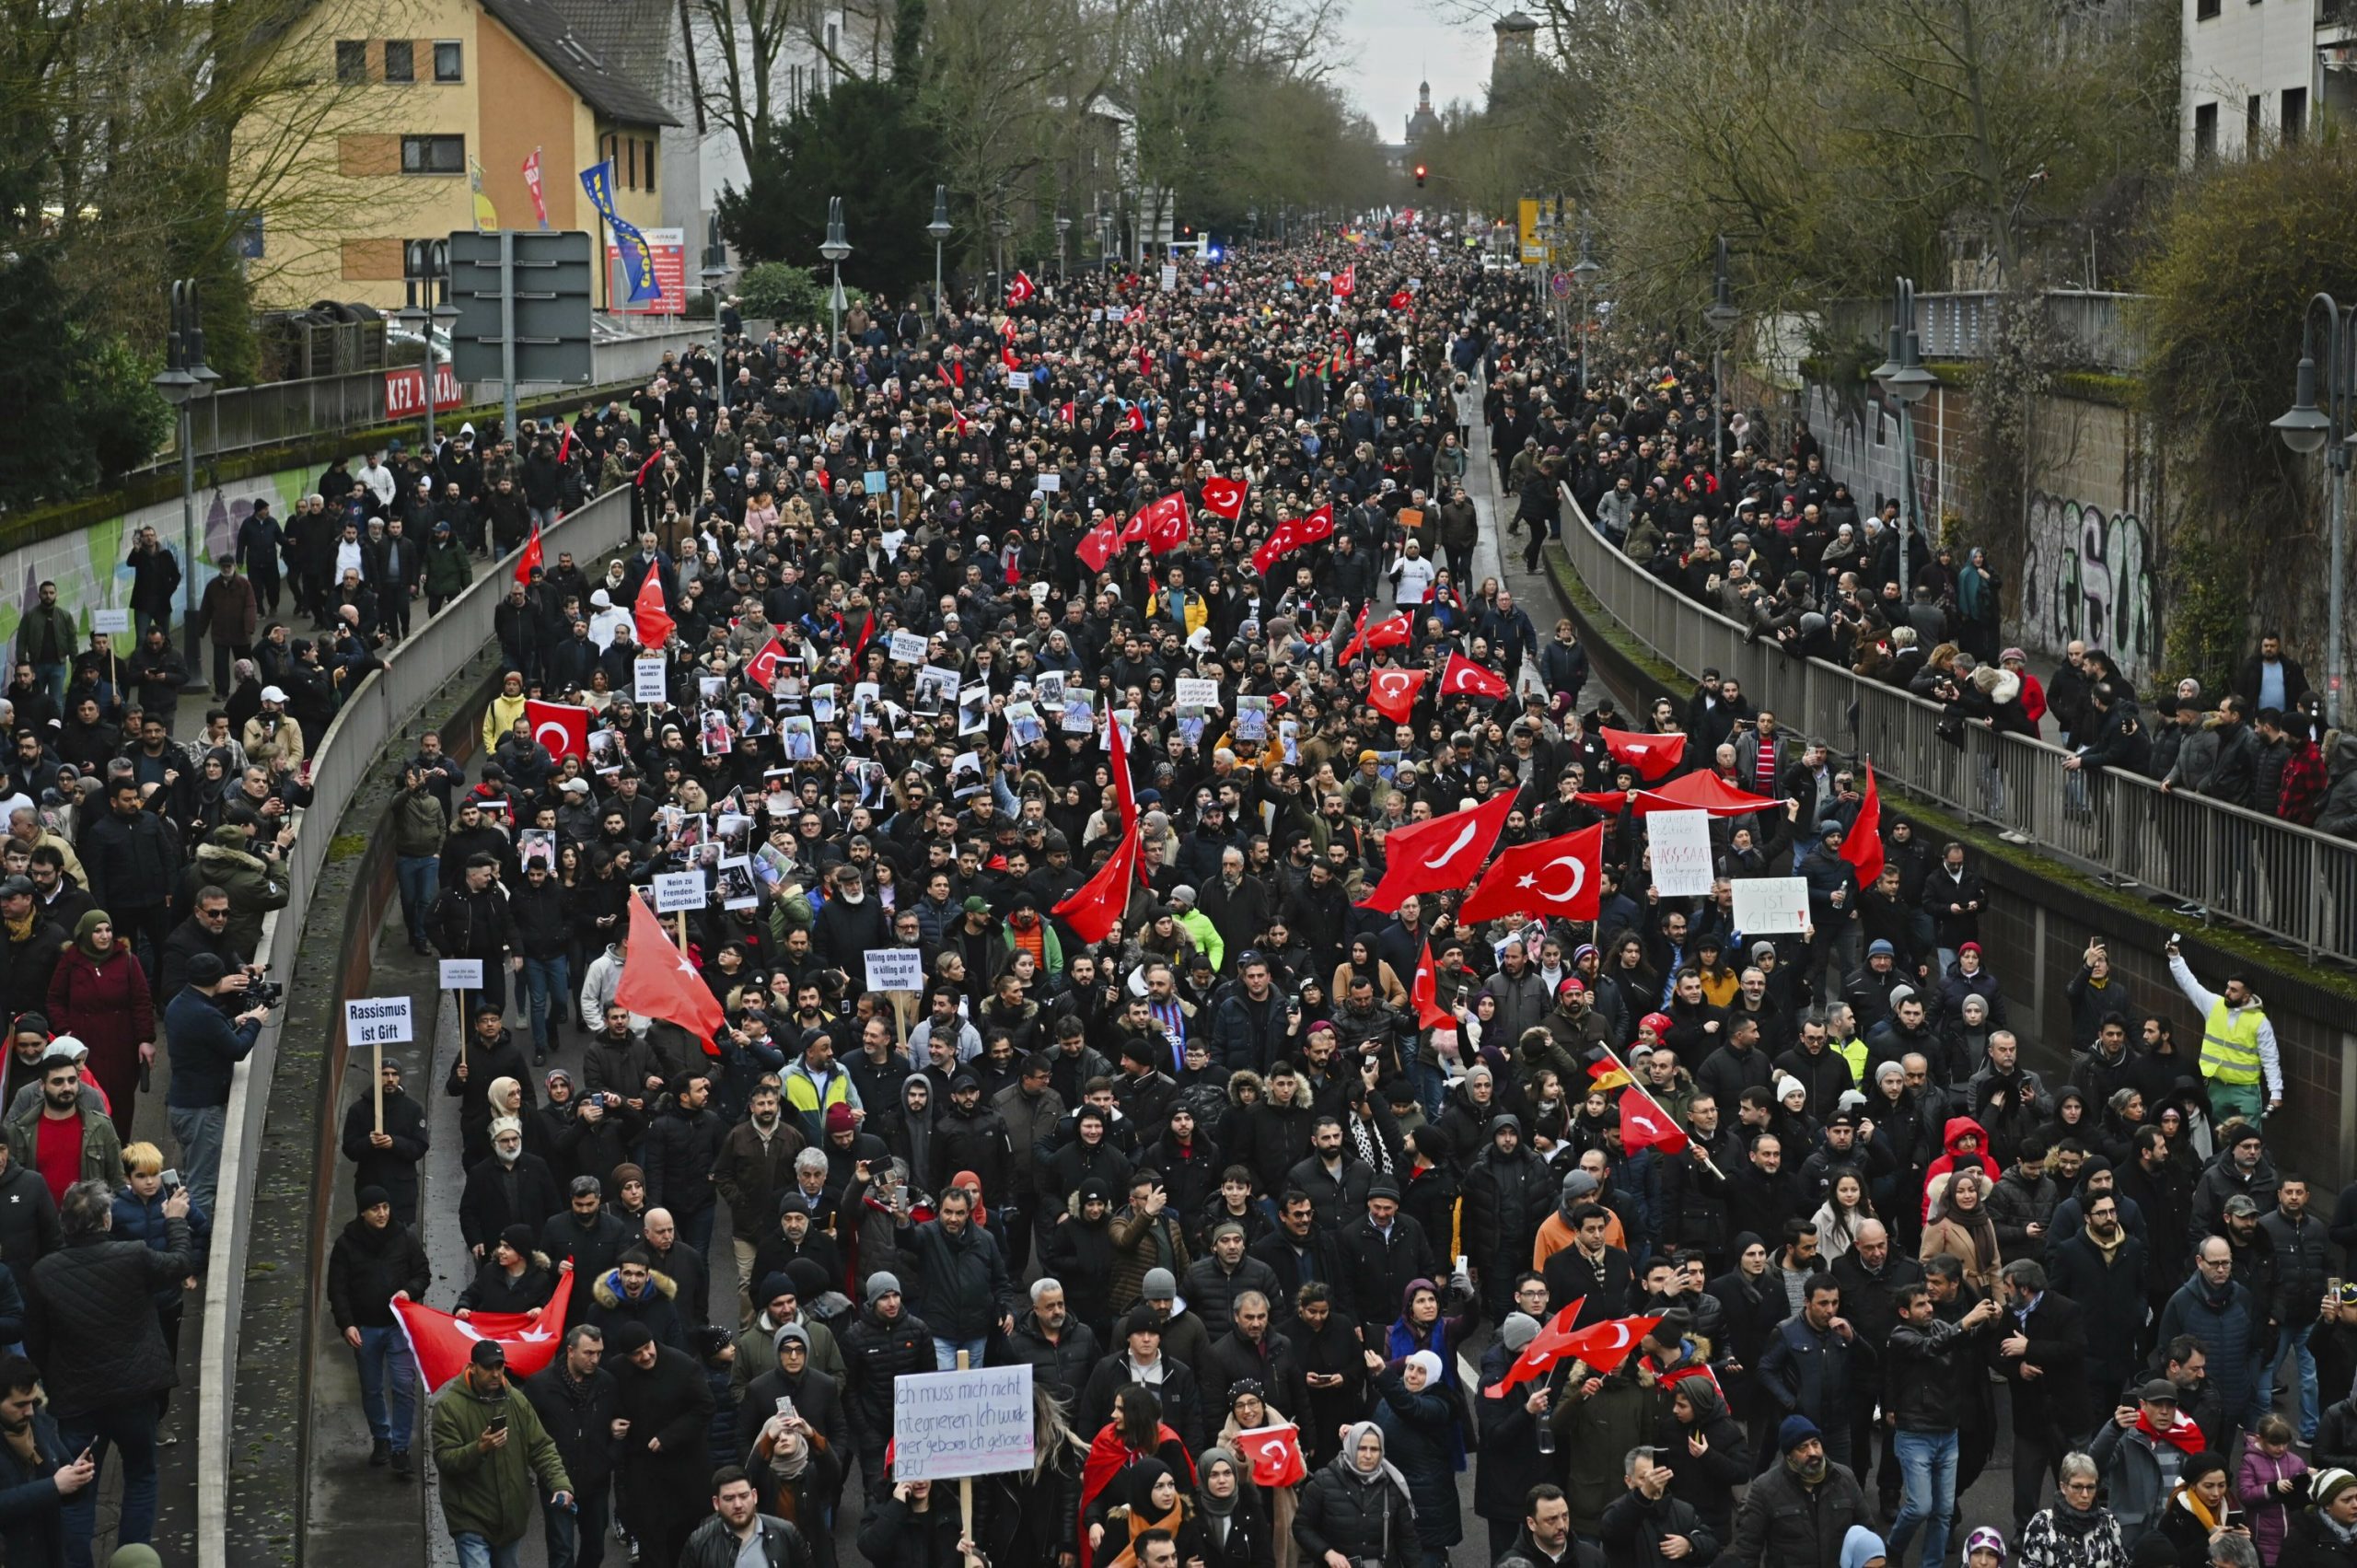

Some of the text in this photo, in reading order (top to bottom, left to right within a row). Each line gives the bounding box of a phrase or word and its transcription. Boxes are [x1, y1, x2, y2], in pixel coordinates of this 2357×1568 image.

[388, 372, 462, 411] KFZ AKAU
[897, 643, 919, 652] POLITIK
[667, 878, 683, 887] Nein
[1734, 878, 1806, 893] ASSISMUS
[663, 888, 696, 898] Fremden-
[659, 896, 702, 908] feindlichkeit
[1763, 894, 1785, 909] IST
[1746, 910, 1805, 932] GIFT!
[866, 952, 918, 964] Killing one human
[873, 964, 914, 976] is killing all of
[881, 977, 909, 988] humanity
[350, 1003, 407, 1020] Rassismus
[361, 1024, 399, 1041] ist Gift
[895, 1373, 1022, 1405] Ich muss mich nicht
[896, 1400, 1028, 1440] Integrieren Ich wurde
[895, 1435, 923, 1457] hier
[969, 1428, 984, 1451] Ich
[895, 1458, 923, 1479] DEU
